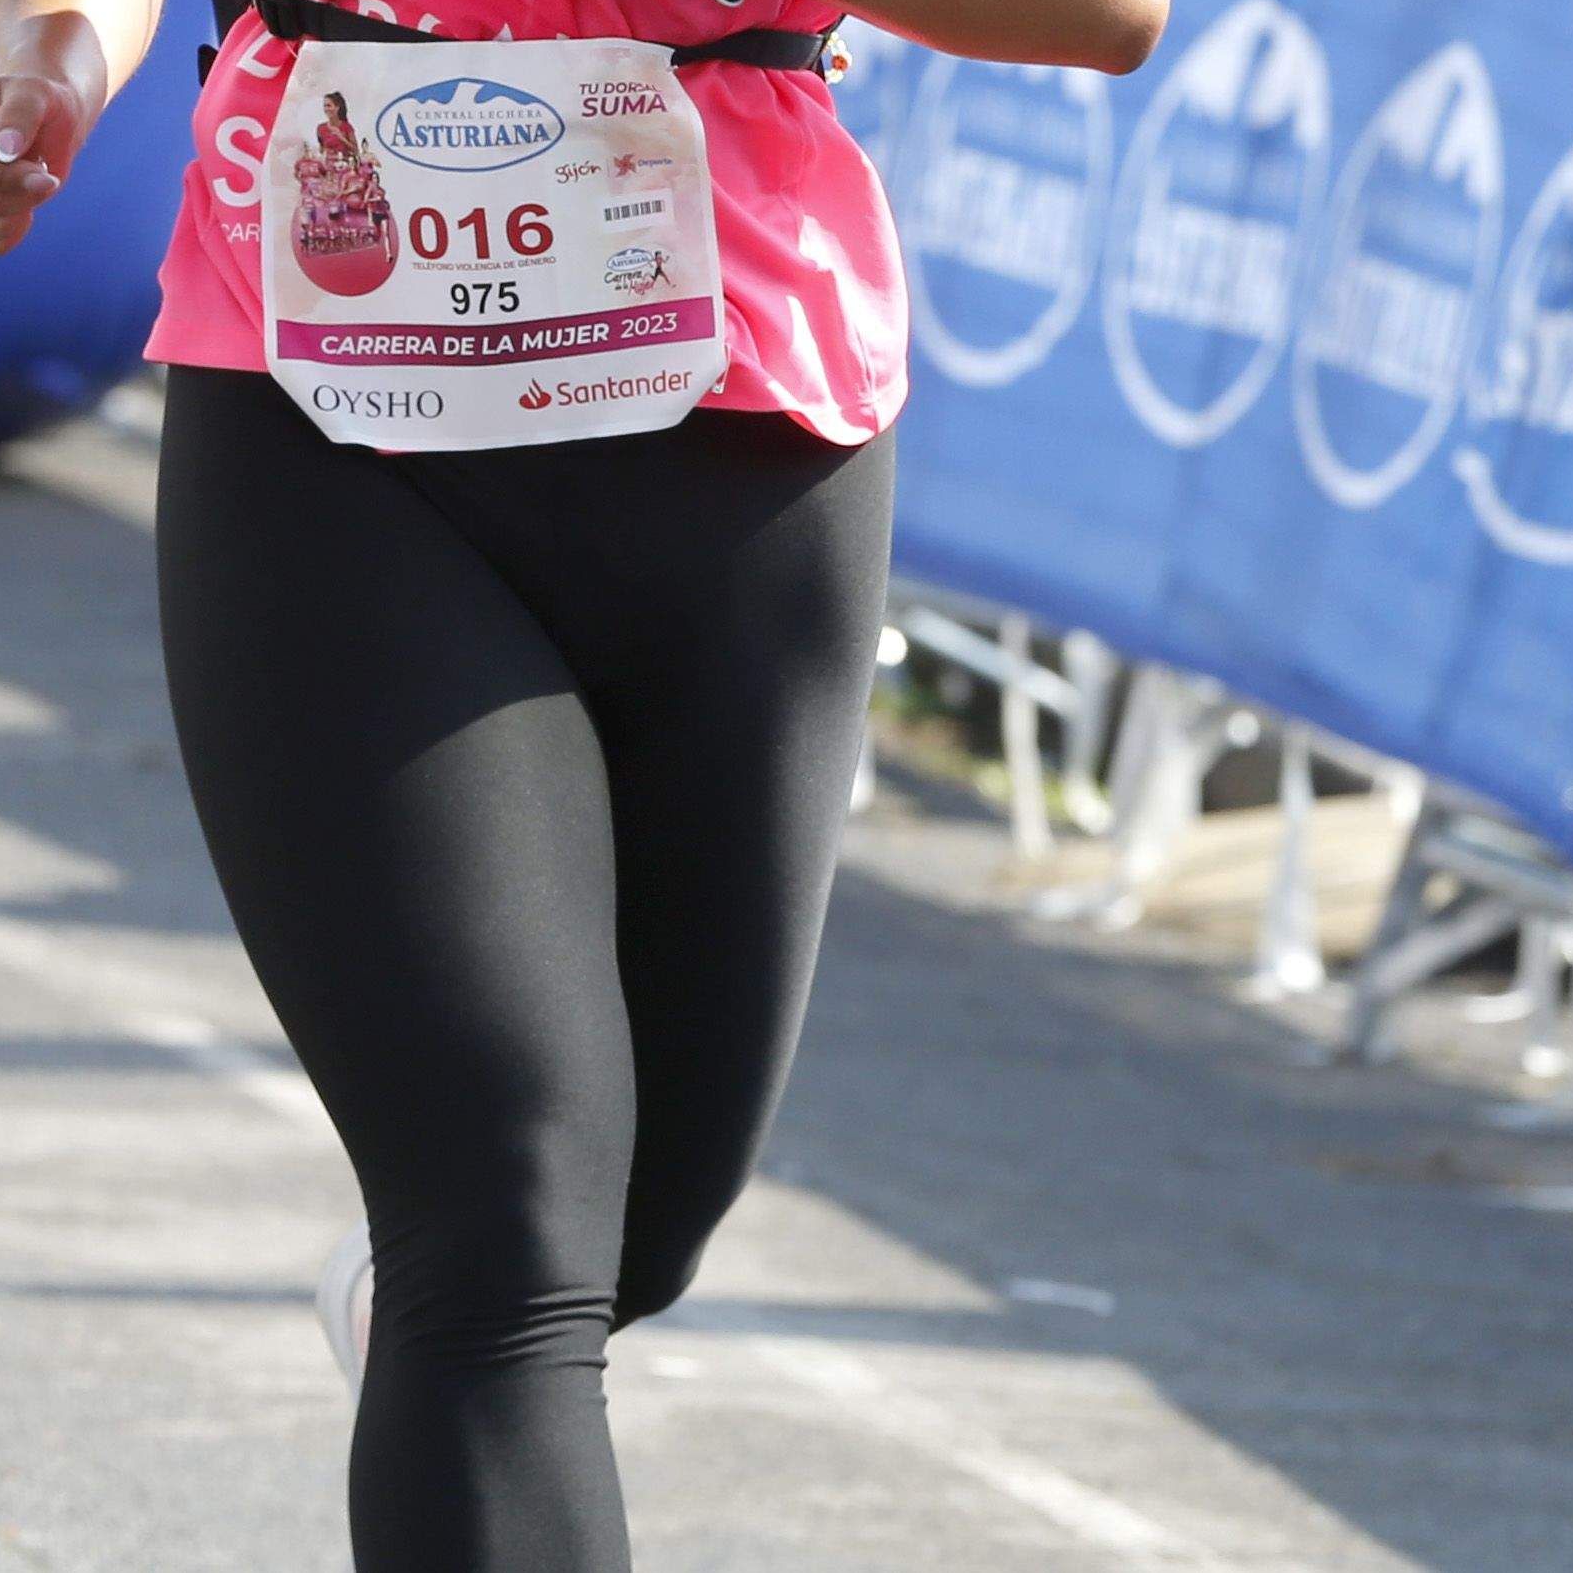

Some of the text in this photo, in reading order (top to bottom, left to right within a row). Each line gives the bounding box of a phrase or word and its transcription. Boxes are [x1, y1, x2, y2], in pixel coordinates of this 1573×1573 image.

[579, 83, 599, 95] TU
[582, 94, 668, 117] SUMA
[391, 112, 551, 148] ASTURIANA
[415, 109, 543, 120] CENTRAL LECHERA
[409, 203, 554, 260] 016
[456, 261, 501, 271] VIOLENCIA
[503, 261, 515, 269] DE
[517, 256, 557, 268] GÉNERO
[450, 281, 520, 315] 975
[321, 313, 678, 356] CARRERA DE LA MUJER 2023
[313, 370, 693, 419] OYSHO Santander
